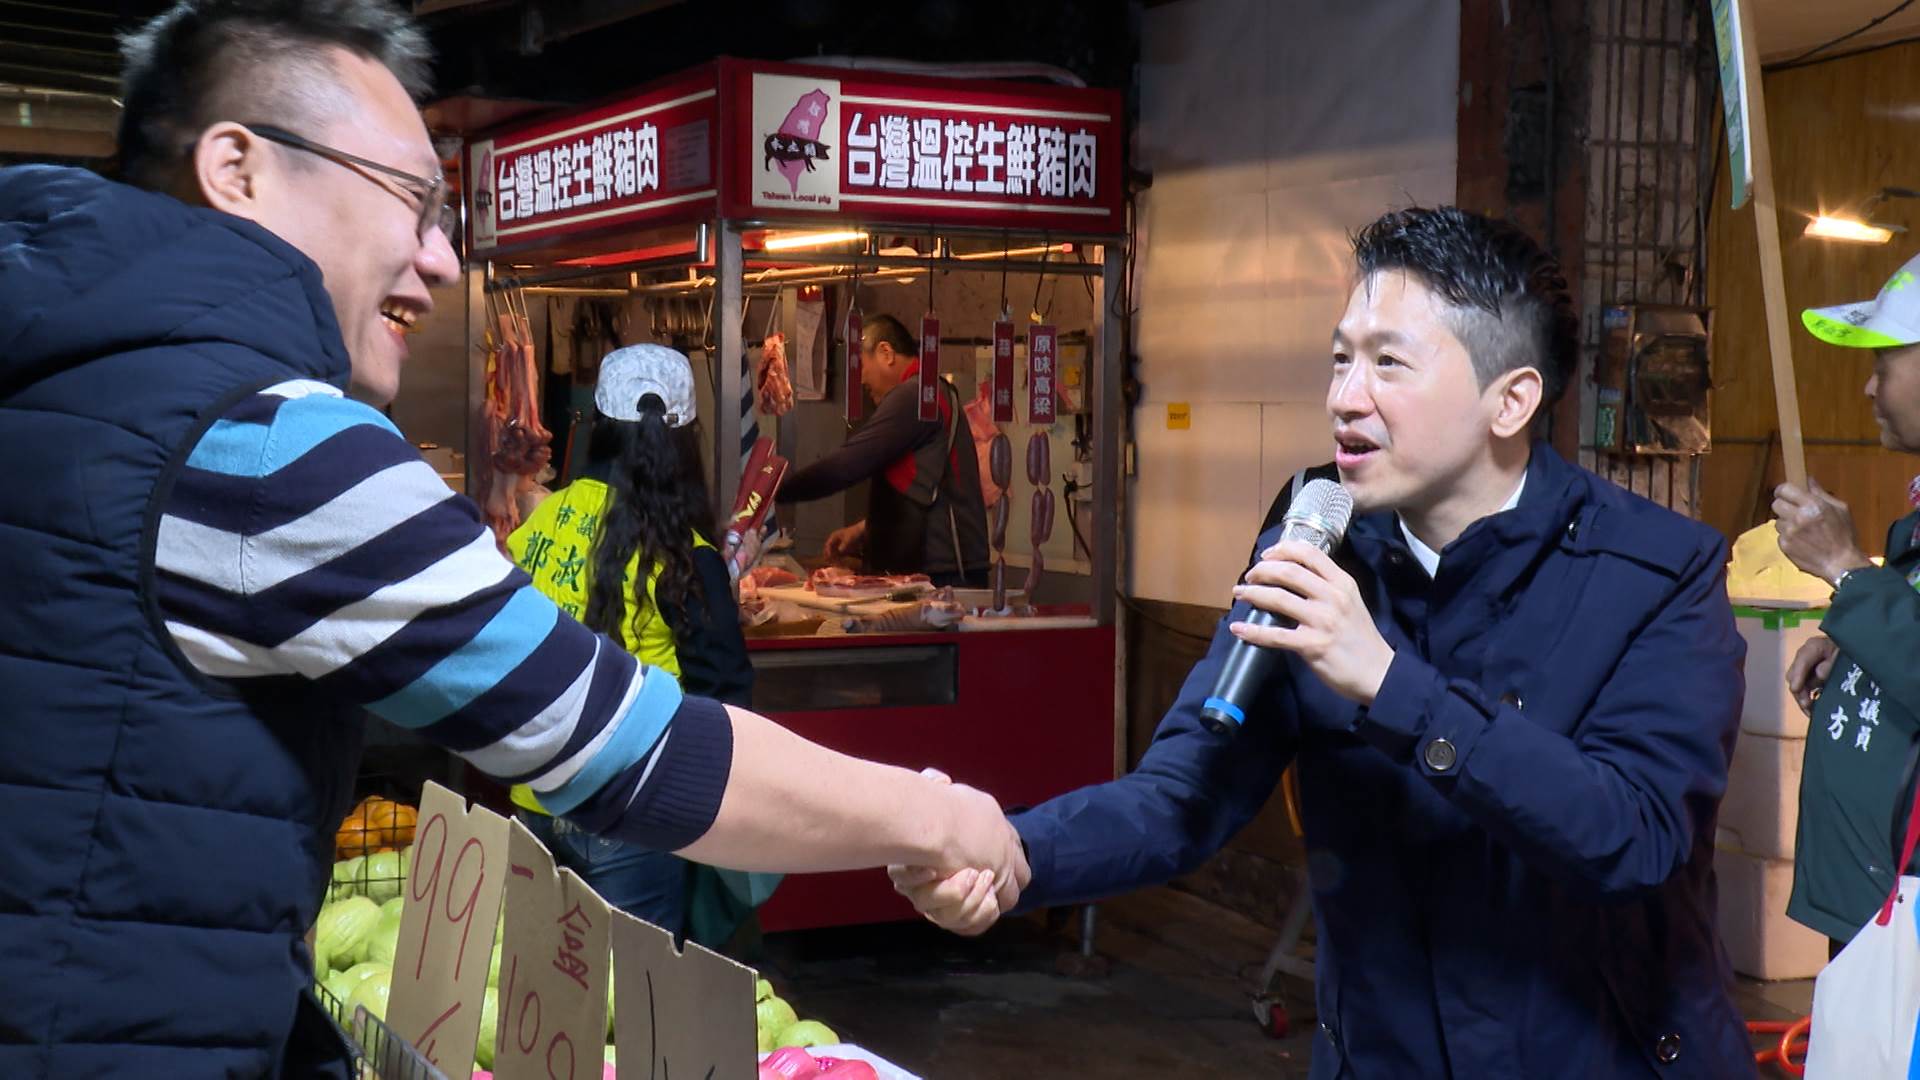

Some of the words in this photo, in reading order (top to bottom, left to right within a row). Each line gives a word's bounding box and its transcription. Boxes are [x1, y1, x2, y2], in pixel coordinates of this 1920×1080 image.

[498, 121, 659, 222] 台灣溫控生鮮豬肉
[762, 191, 791, 201] Taiwan
[793, 193, 816, 202] Local
[847, 112, 1097, 199] 台灣溫控生鮮豬肉
[412, 813, 485, 982] 99
